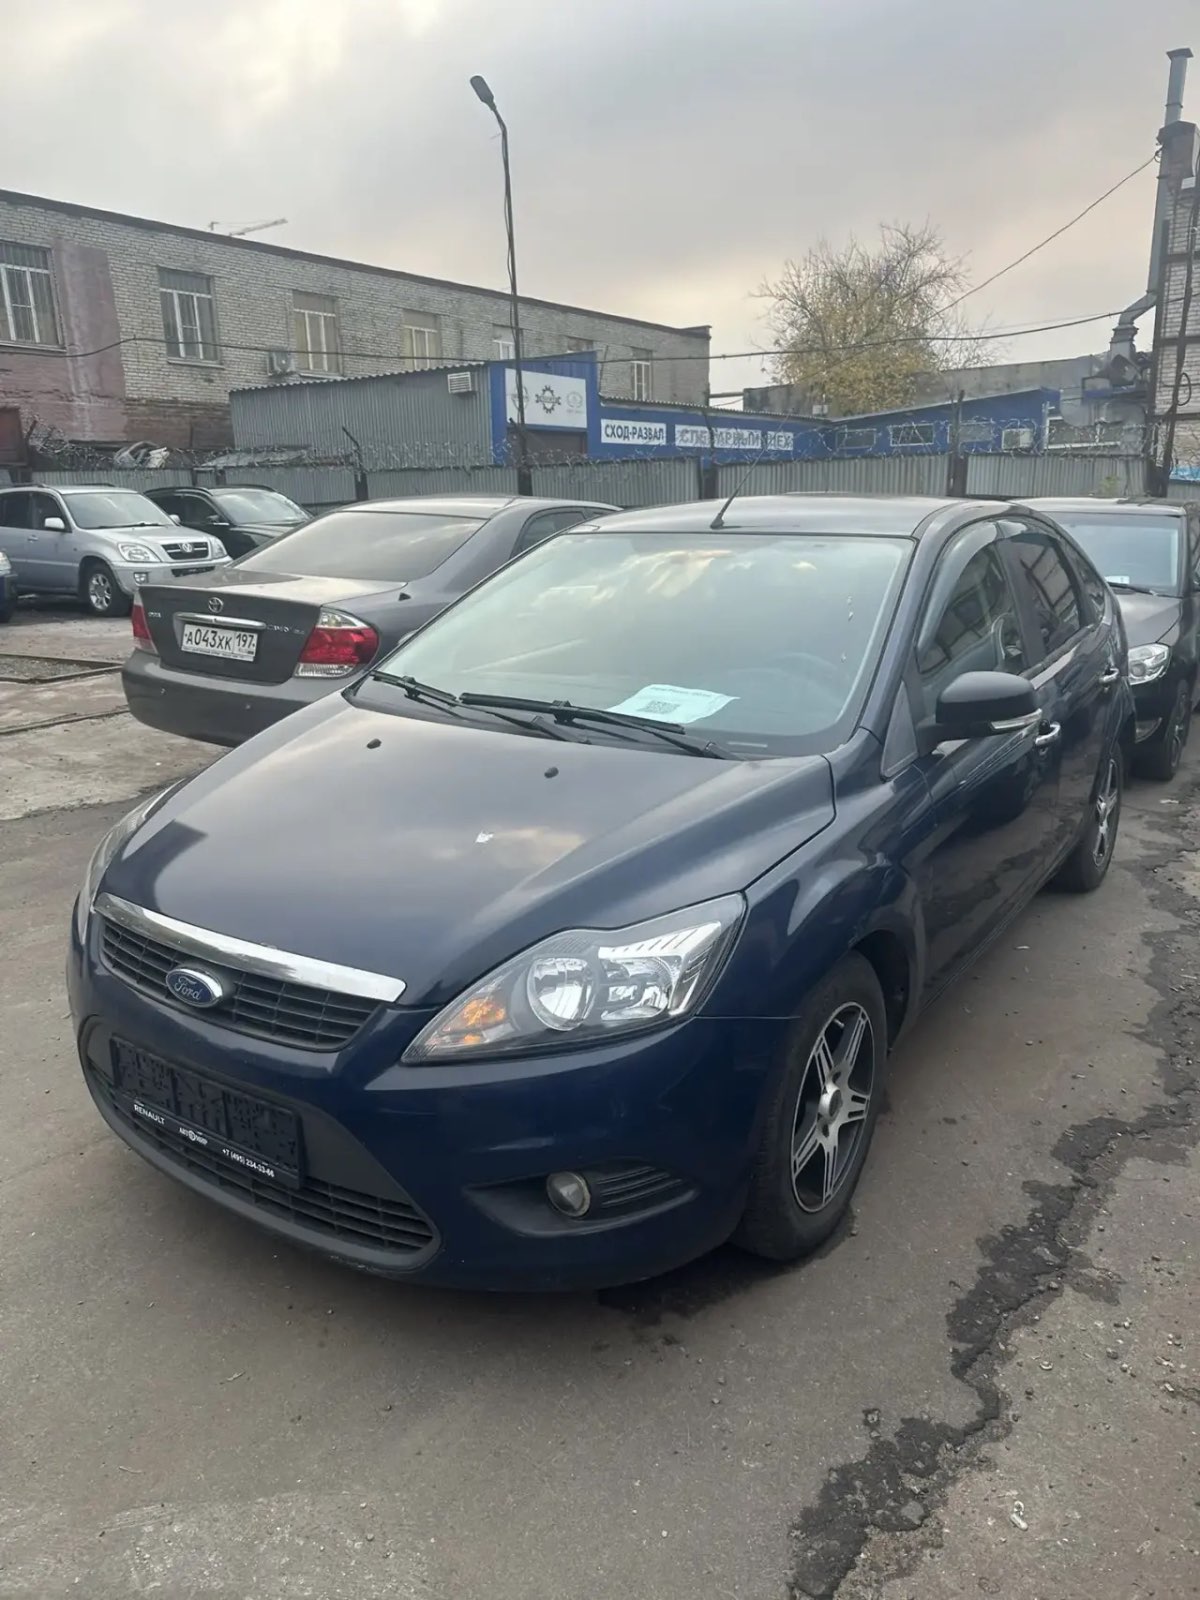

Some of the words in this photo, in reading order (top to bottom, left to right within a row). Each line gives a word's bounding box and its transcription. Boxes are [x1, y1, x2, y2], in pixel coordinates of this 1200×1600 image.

[604, 424, 664, 442] СХОД-РАЗВАЛ
[236, 632, 254, 649] 197
[174, 975, 203, 1001] Ford
[134, 1104, 165, 1124] RENAULT
